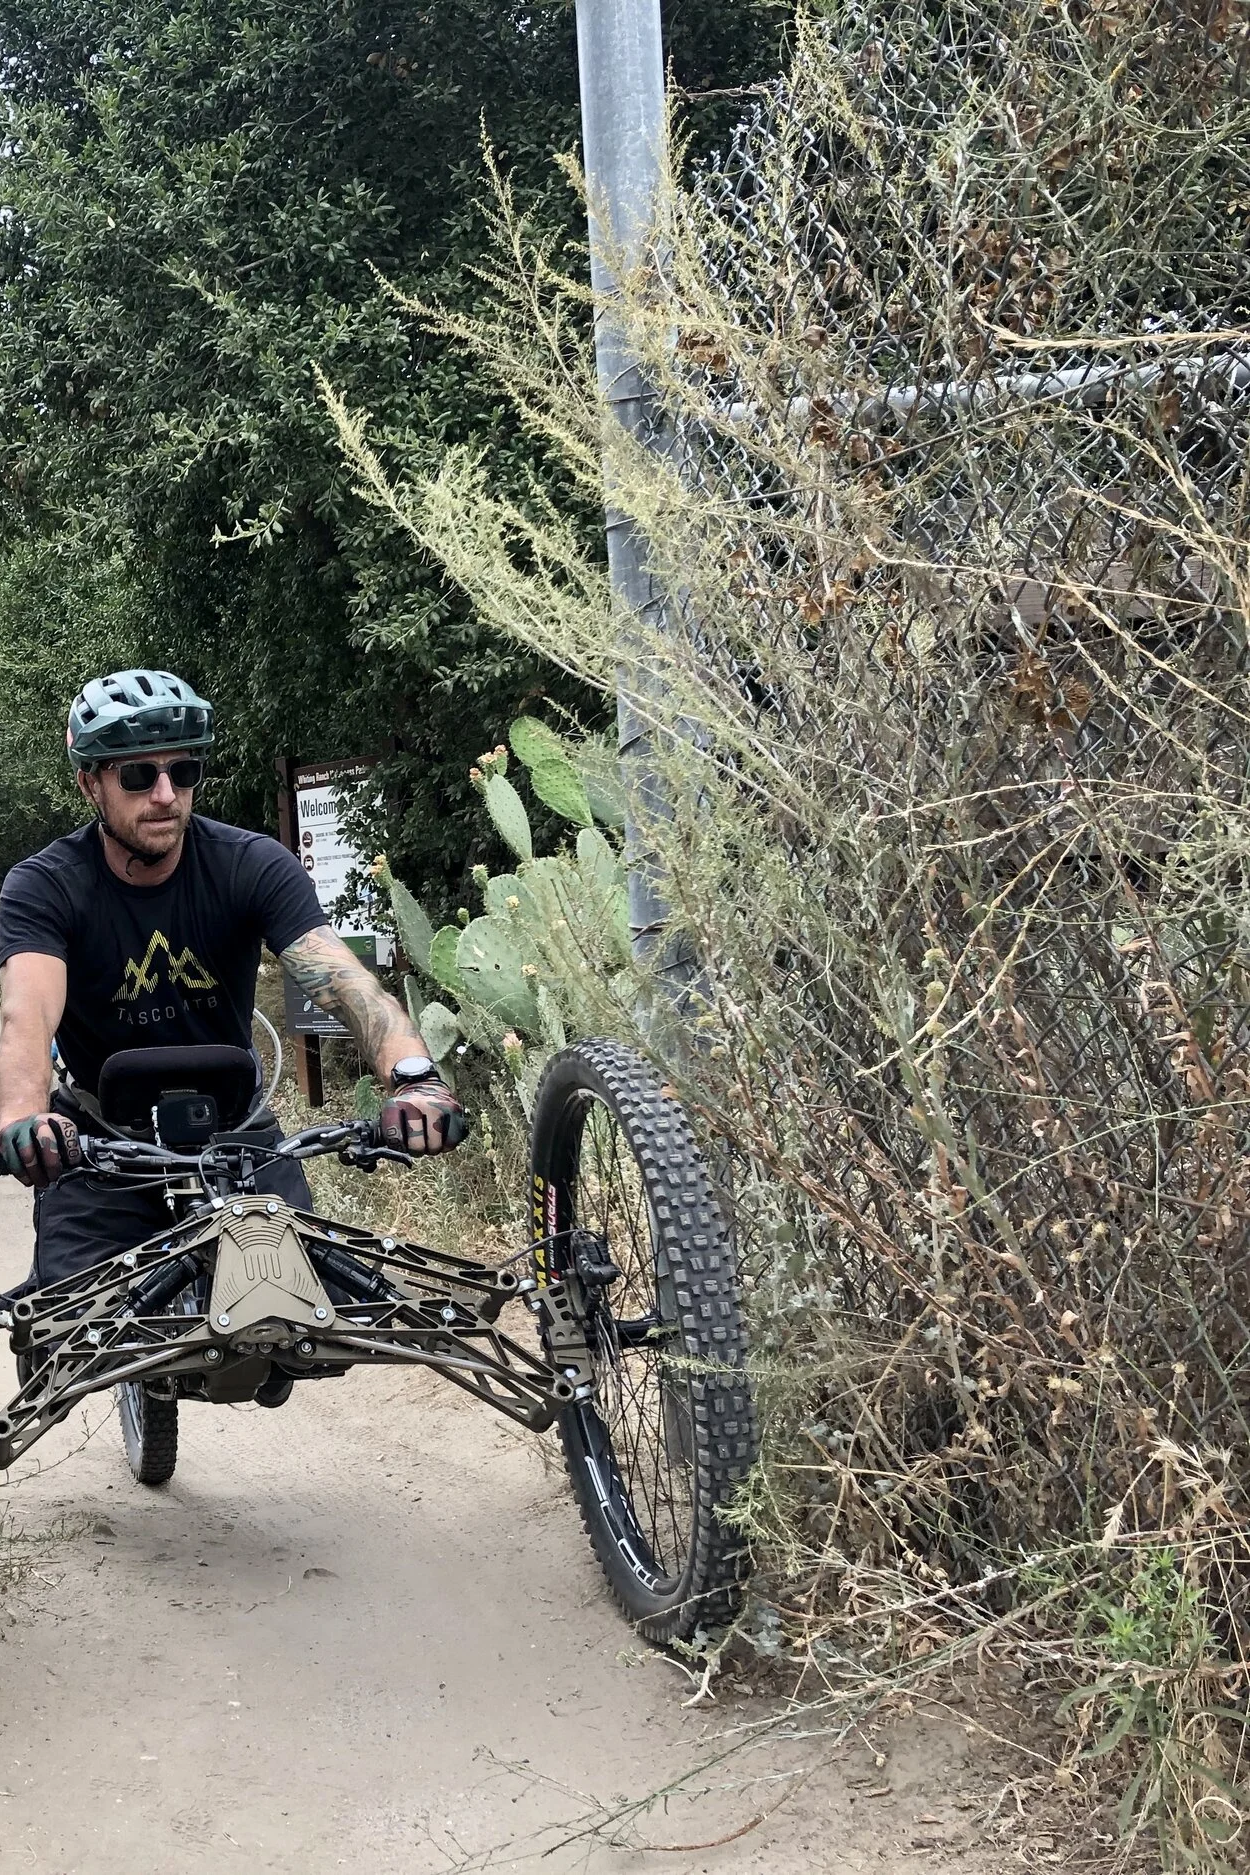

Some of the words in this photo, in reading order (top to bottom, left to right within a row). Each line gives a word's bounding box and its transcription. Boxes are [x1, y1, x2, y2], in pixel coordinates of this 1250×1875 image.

[300, 798, 336, 818] Welcom
[118, 1006, 175, 1024] TASCO
[62, 1119, 79, 1158] ASCO
[533, 1172, 547, 1291] MAXXIS
